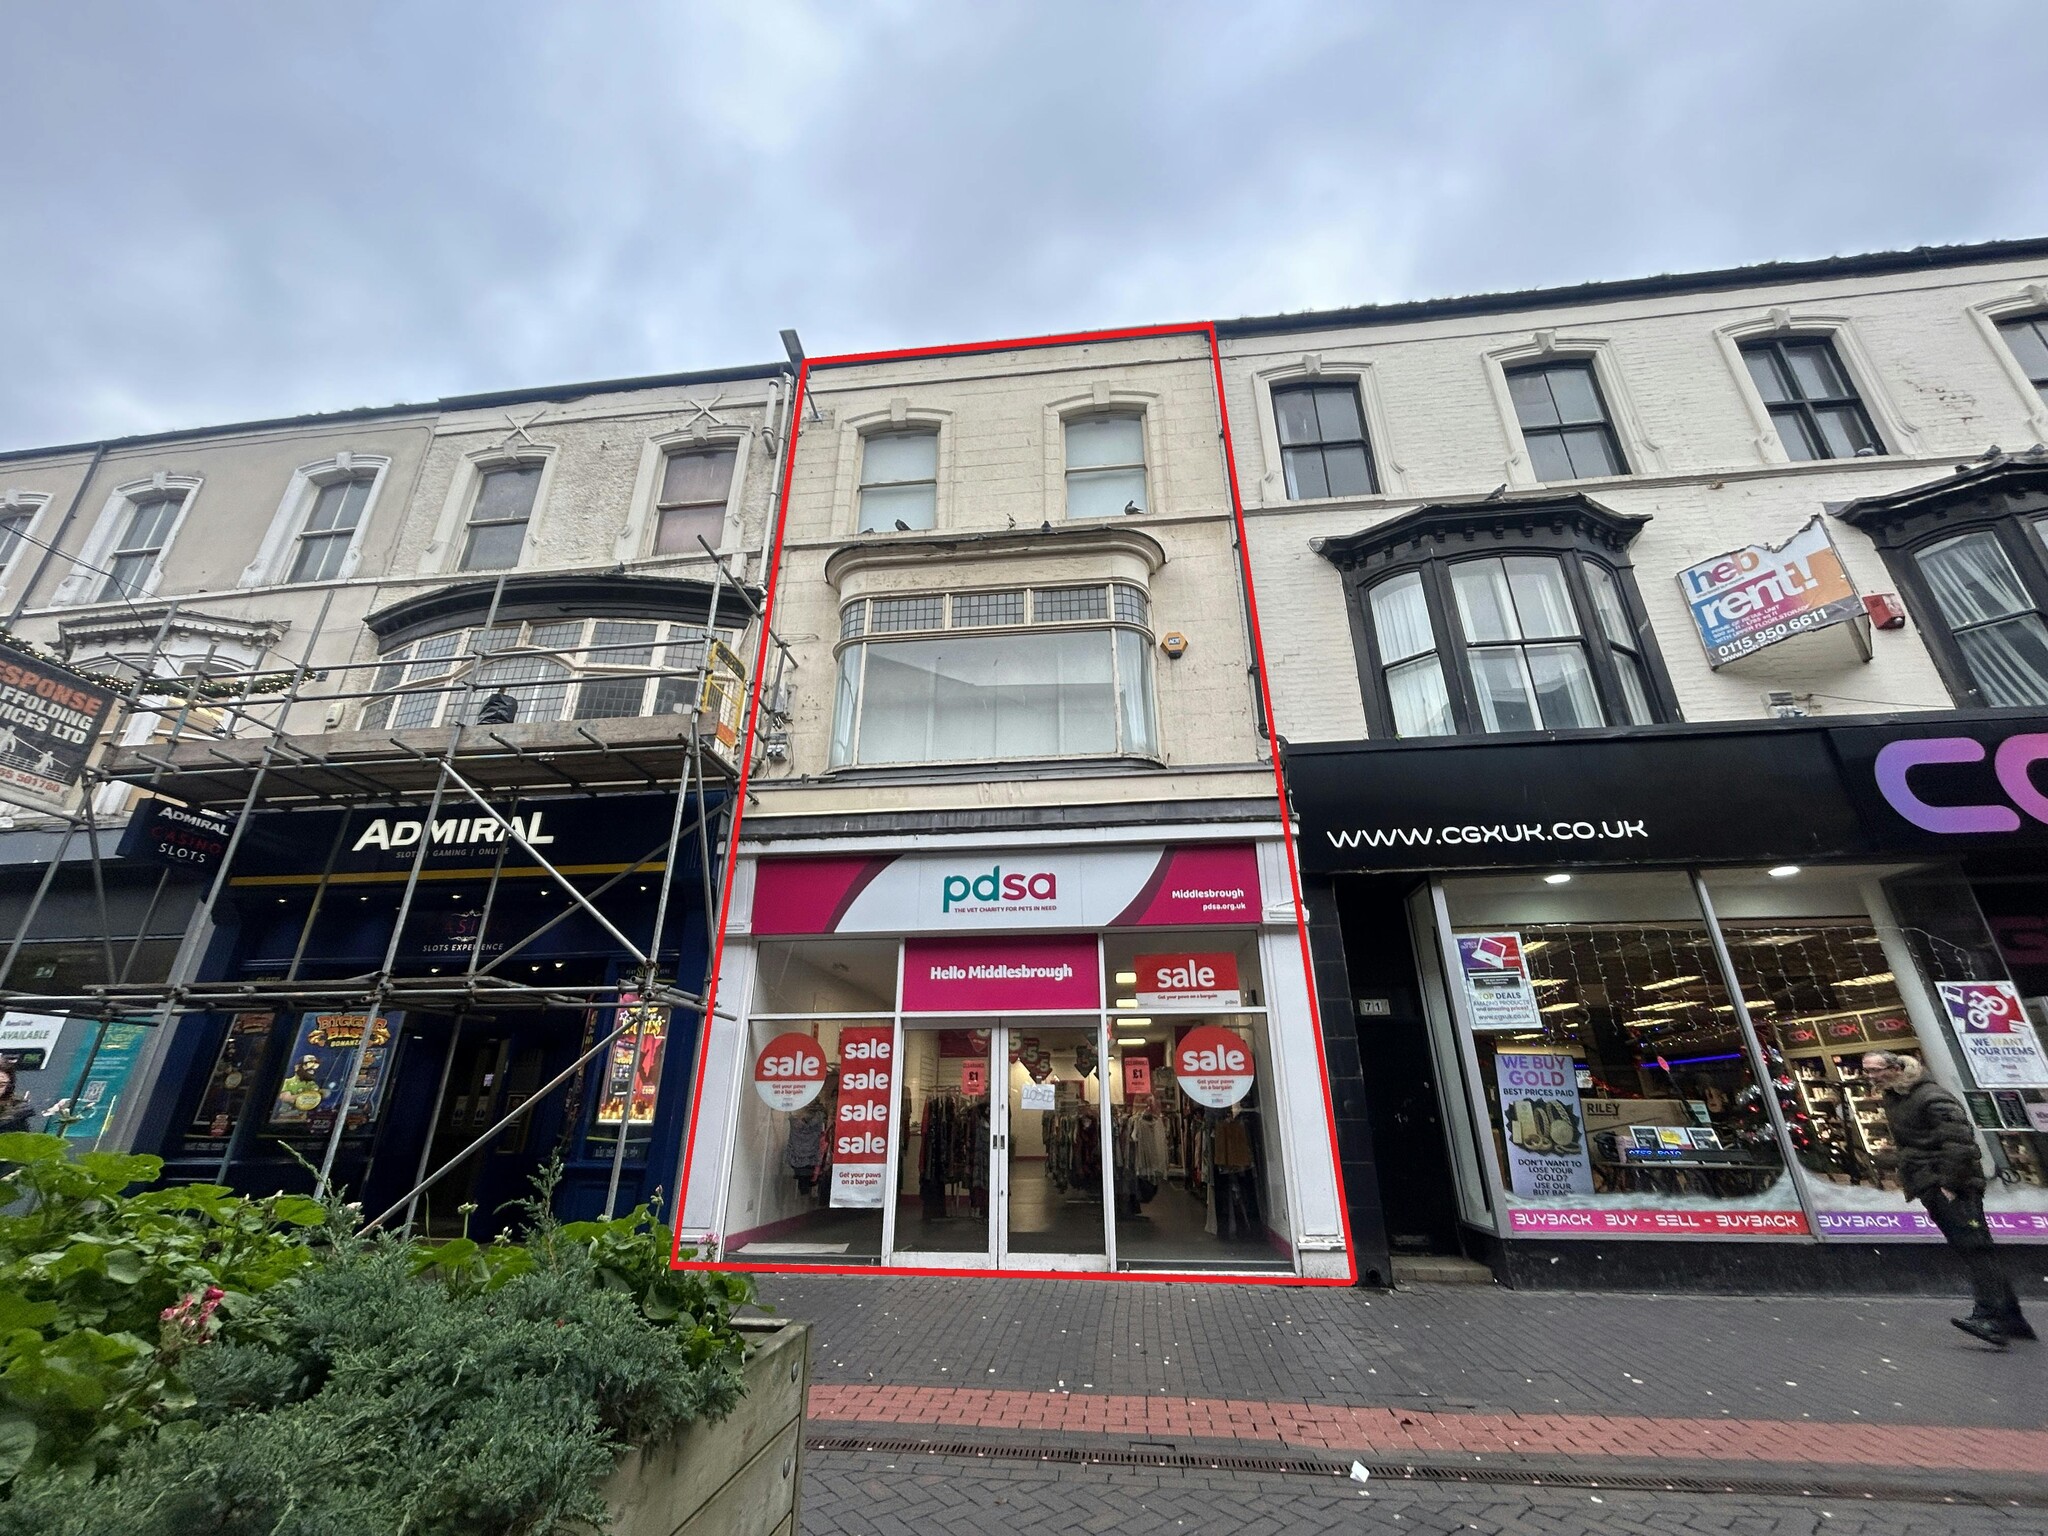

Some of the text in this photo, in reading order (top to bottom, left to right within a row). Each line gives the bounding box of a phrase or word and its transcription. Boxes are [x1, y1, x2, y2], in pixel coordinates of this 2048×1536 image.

[1688, 551, 1760, 594] heb
[1701, 555, 1818, 628] rent!
[1718, 608, 1828, 657] 0115 950 6611
[0, 683, 94, 731] FFOLDING
[51, 722, 87, 745] LTD
[158, 806, 230, 837] ADMIRAL
[351, 811, 554, 851] ADMIRAL
[158, 842, 206, 863] SLOTS
[396, 847, 510, 859] SLOT GAMING ONLIE
[943, 865, 1056, 913] pdsa
[1172, 888, 1244, 899] Middlesbrough
[1202, 902, 1246, 911] pdsa.org.uk
[422, 943, 504, 952] SLOTS EXPEENCE
[930, 963, 1073, 981] Hello Middlesbrough
[1156, 959, 1215, 988] sale
[1365, 1002, 1380, 1010] 71
[318, 1016, 387, 1030] BIGGR
[0, 1030, 50, 1040] AVAILABLE
[327, 1028, 364, 1040] BAS
[1972, 1038, 2024, 1046] WE WANT
[330, 1040, 362, 1048] BONANZ
[845, 1038, 890, 1059] sale
[2001, 1047, 2035, 1055] ITEMS
[763, 1051, 820, 1077] sale
[1182, 1044, 1245, 1072] sale
[1502, 1055, 1565, 1070] WE BUY
[843, 1068, 889, 1090] sale
[969, 1072, 978, 1081] £1
[1133, 1069, 1142, 1078] £1
[1509, 1070, 1565, 1086] GOLD
[840, 1100, 887, 1121] sale
[1587, 1104, 1620, 1115] RILEY
[838, 1132, 886, 1154] sale
[1515, 1213, 1798, 1227] BUYBACK BUY SELL BUYBACK
[1818, 1215, 1901, 1227] BUYBACK
[1913, 1215, 1937, 1228] BU
[1986, 1215, 2015, 1228] ELL
